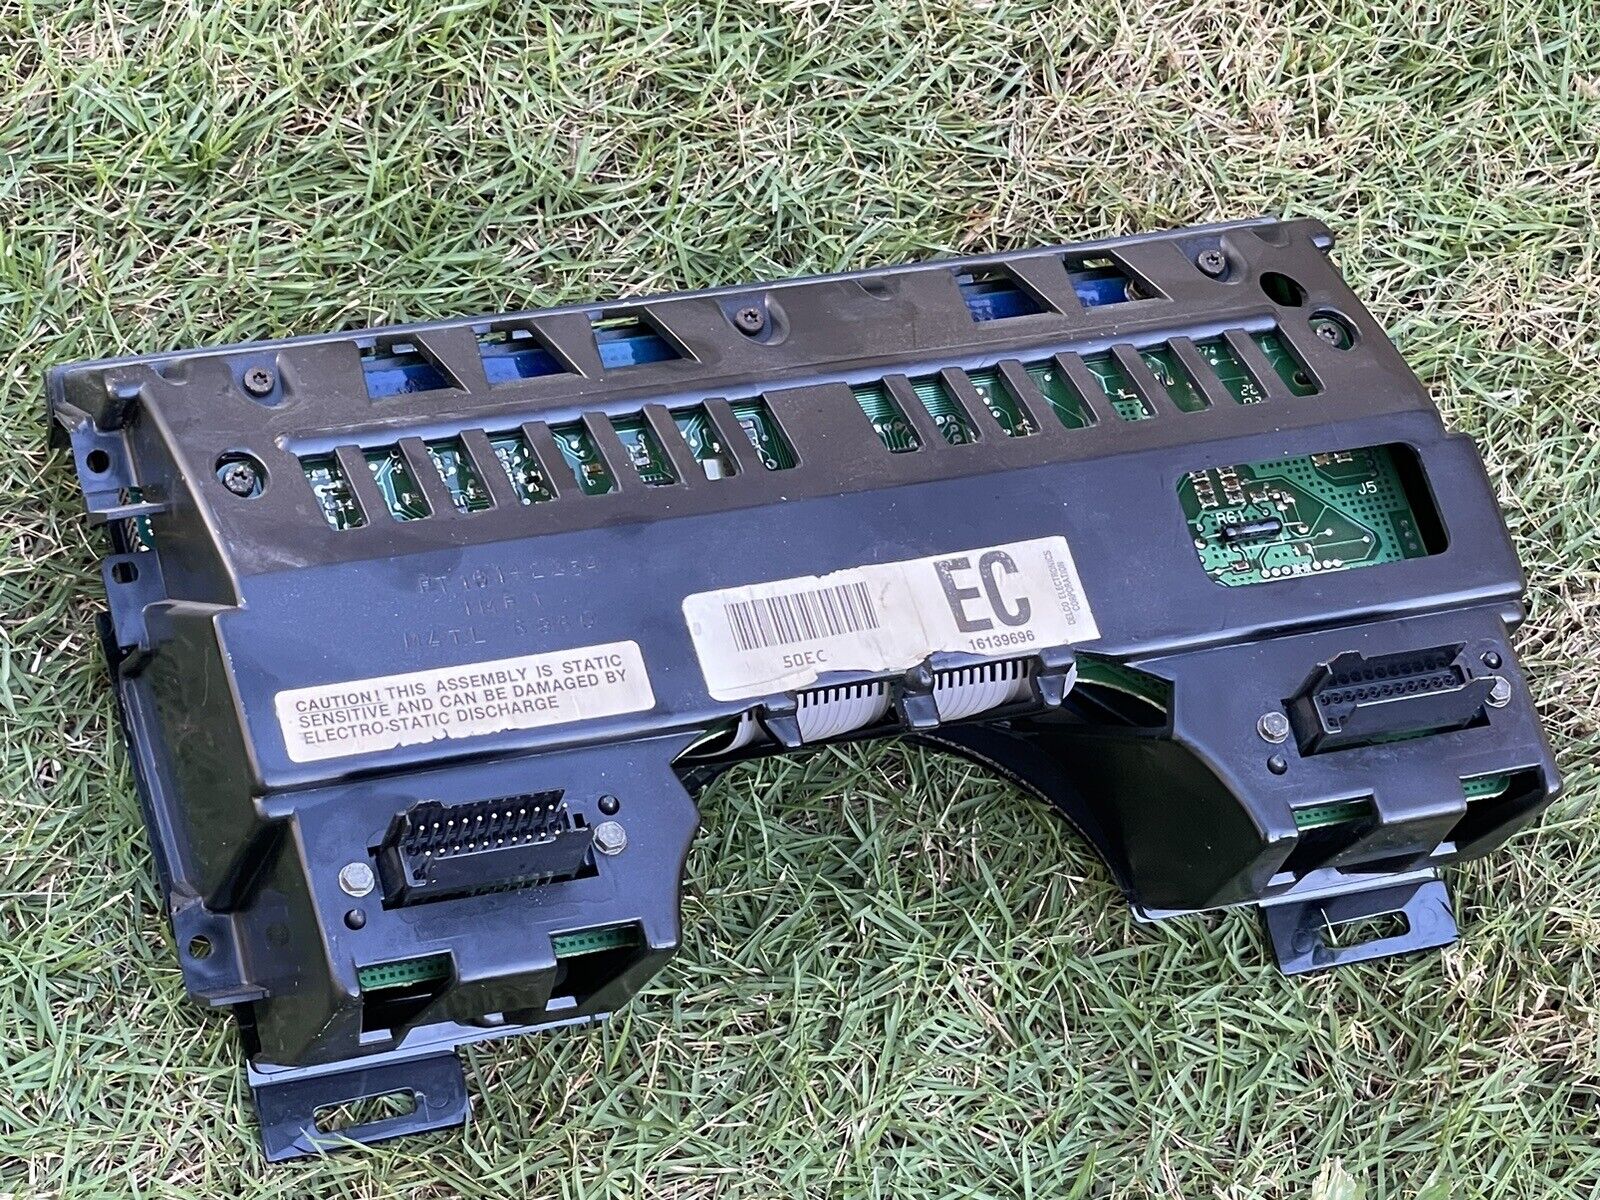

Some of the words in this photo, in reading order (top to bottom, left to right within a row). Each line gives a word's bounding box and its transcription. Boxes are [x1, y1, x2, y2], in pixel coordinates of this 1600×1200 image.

[1358, 480, 1378, 495] J5
[1215, 510, 1246, 524] R61
[933, 550, 1031, 633] EC
[1042, 550, 1067, 600] ELECTRONICS
[1056, 561, 1080, 612] CORPORATION
[1061, 601, 1077, 626] DELCO
[968, 629, 1036, 651] 16139696
[295, 689, 382, 713] CAUTION!
[387, 682, 427, 700] THIS
[436, 667, 527, 693] ASSEMBLY
[536, 664, 553, 679] IS
[562, 653, 622, 675] STATIC
[299, 704, 391, 729] SENSITIVE
[397, 697, 434, 715] AND
[440, 690, 477, 708] CAN
[484, 686, 508, 702] BE
[513, 672, 599, 698] DAMAGED
[606, 668, 628, 684] BY
[303, 711, 450, 745] ELECTRO-STATIC
[457, 695, 560, 722] DISCHARGE
